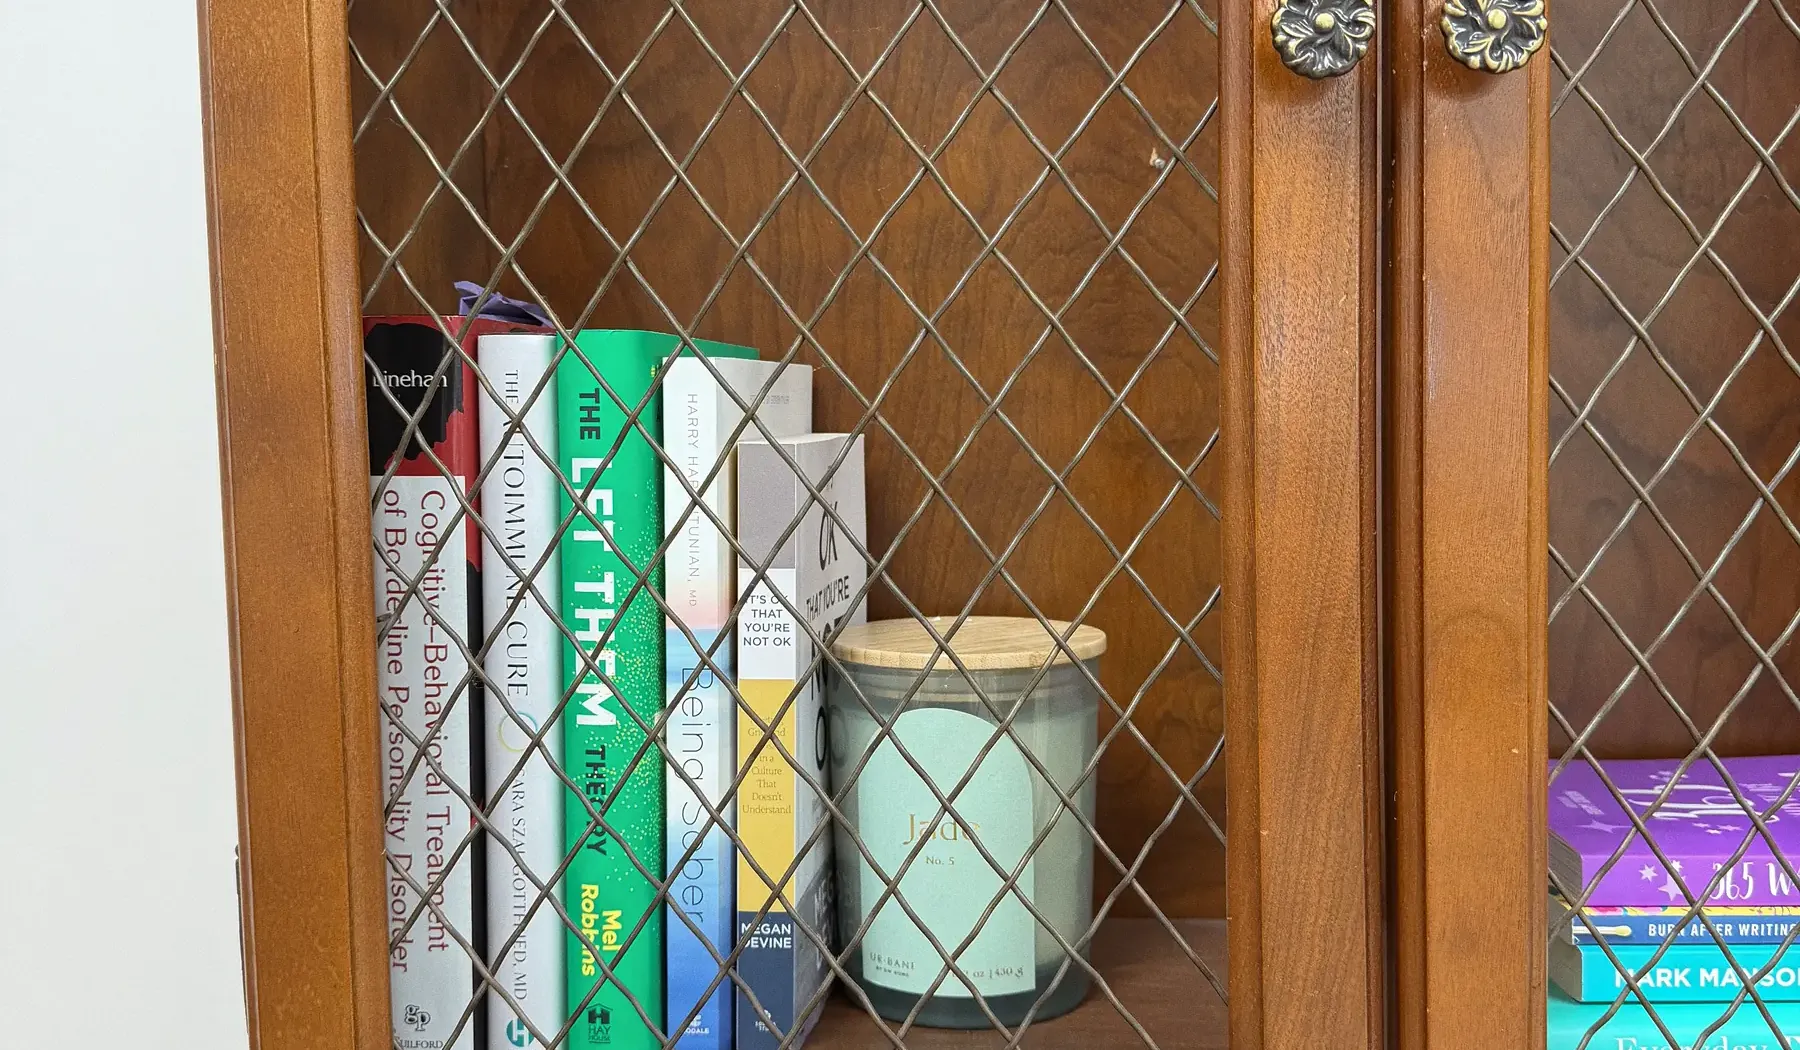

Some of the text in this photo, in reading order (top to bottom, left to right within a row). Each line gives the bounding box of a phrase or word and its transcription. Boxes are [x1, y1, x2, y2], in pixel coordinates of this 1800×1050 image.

[372, 369, 448, 387] Linehan
[579, 388, 601, 440] THE
[383, 489, 407, 519] of
[572, 457, 614, 552] LET
[687, 393, 700, 607] HARRY HARTUNIAN, MD
[503, 369, 528, 696] THE UTOIMMUNE CURE
[819, 500, 838, 571] OK
[747, 595, 788, 604] T'S O
[806, 575, 850, 623] THAT YOU'RE
[751, 609, 783, 618] THAT
[744, 623, 790, 632] YOU'RE
[574, 571, 617, 726] THEM
[743, 637, 791, 646] NOT OK
[747, 728, 766, 737] Gri
[751, 766, 782, 775] Culture
[674, 667, 714, 923] Being Sober
[757, 780, 776, 788] That
[752, 792, 782, 801] Doesn't
[742, 805, 792, 814] Understand
[926, 856, 955, 865] No. 5
[426, 805, 450, 952] Treatment
[1710, 862, 1754, 900] 365
[512, 862, 527, 966] GOTTFIED,
[602, 910, 622, 951] Mel
[741, 923, 791, 935] MEGAN
[1648, 924, 1685, 936] BURN
[513, 973, 528, 1000] MD
[1615, 967, 1800, 988] MARK MASO
[404, 1004, 431, 1032] gp
[394, 1039, 443, 1049] UILFORD
